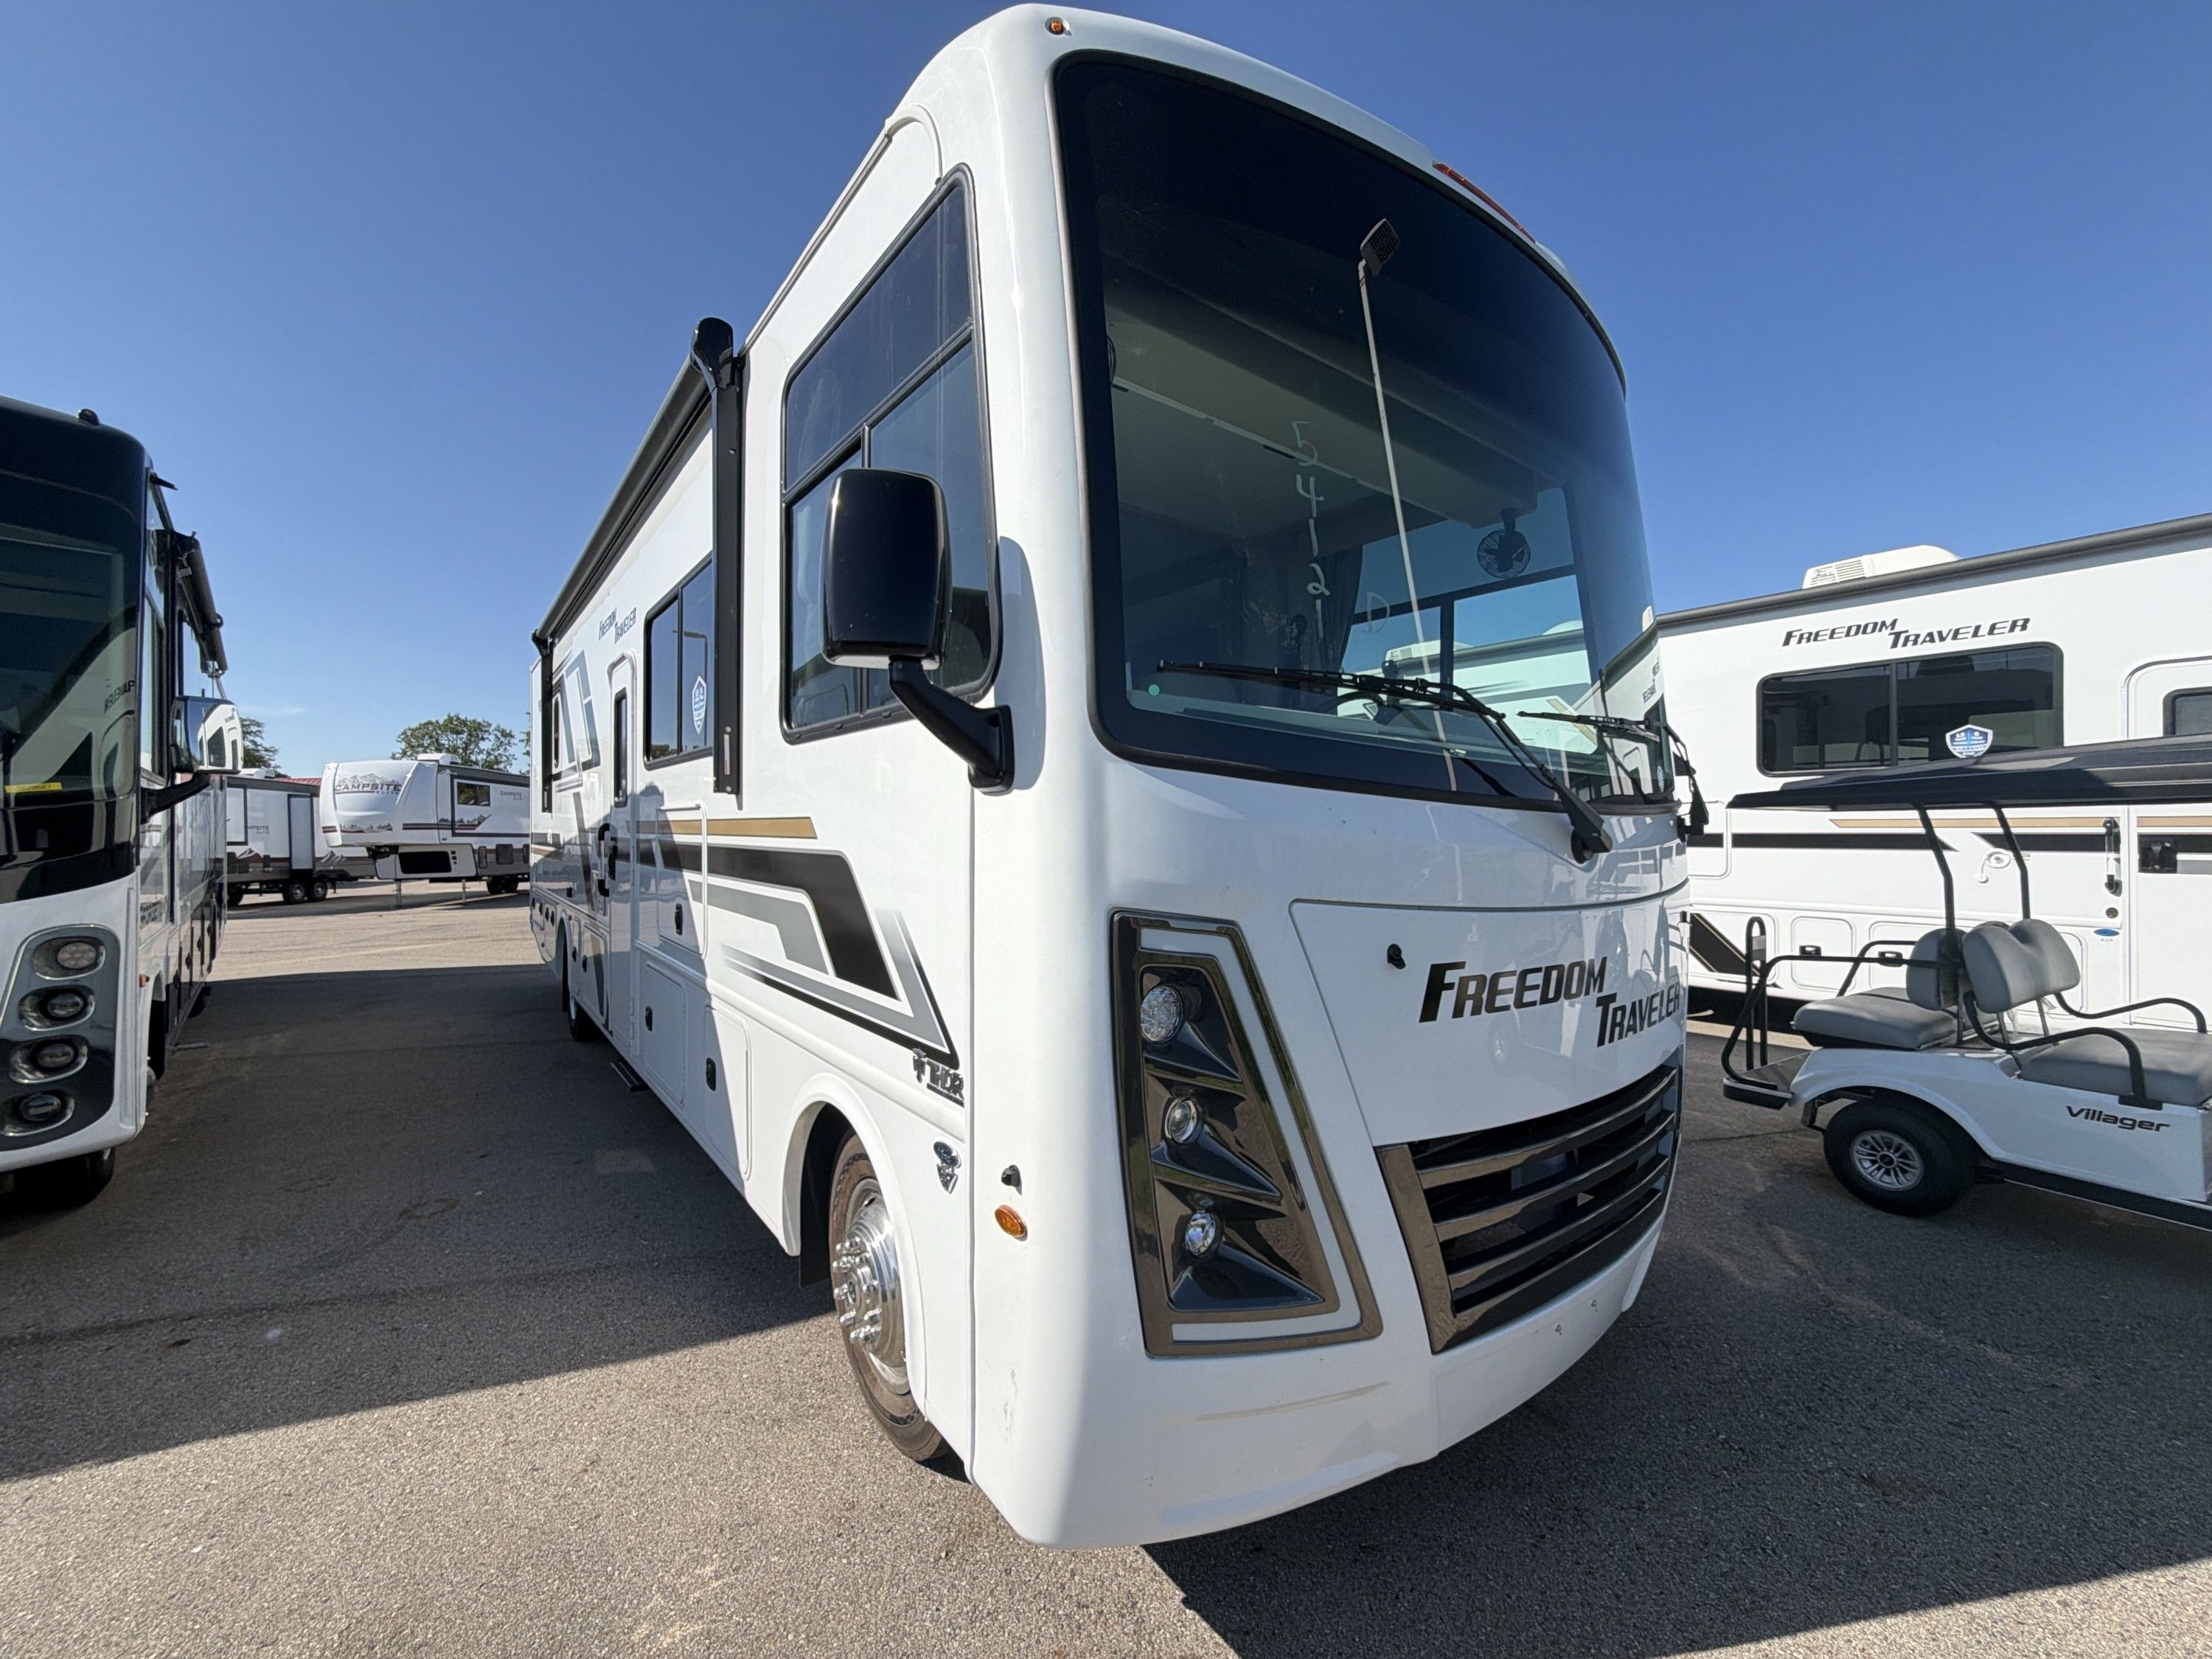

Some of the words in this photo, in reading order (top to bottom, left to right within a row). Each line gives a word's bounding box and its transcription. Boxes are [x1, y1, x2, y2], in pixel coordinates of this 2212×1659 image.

[599, 608, 617, 641] FREEDOM
[1782, 618, 1899, 647] FREEDOM
[1888, 618, 2031, 649] TRAVELER
[335, 783, 403, 793] CAMPSITE
[1419, 956, 1608, 1023] FREEDOM
[1596, 979, 1682, 1048] TRAVELER
[927, 1057, 965, 1102] THOR
[2066, 1105, 2171, 1132] Villager
